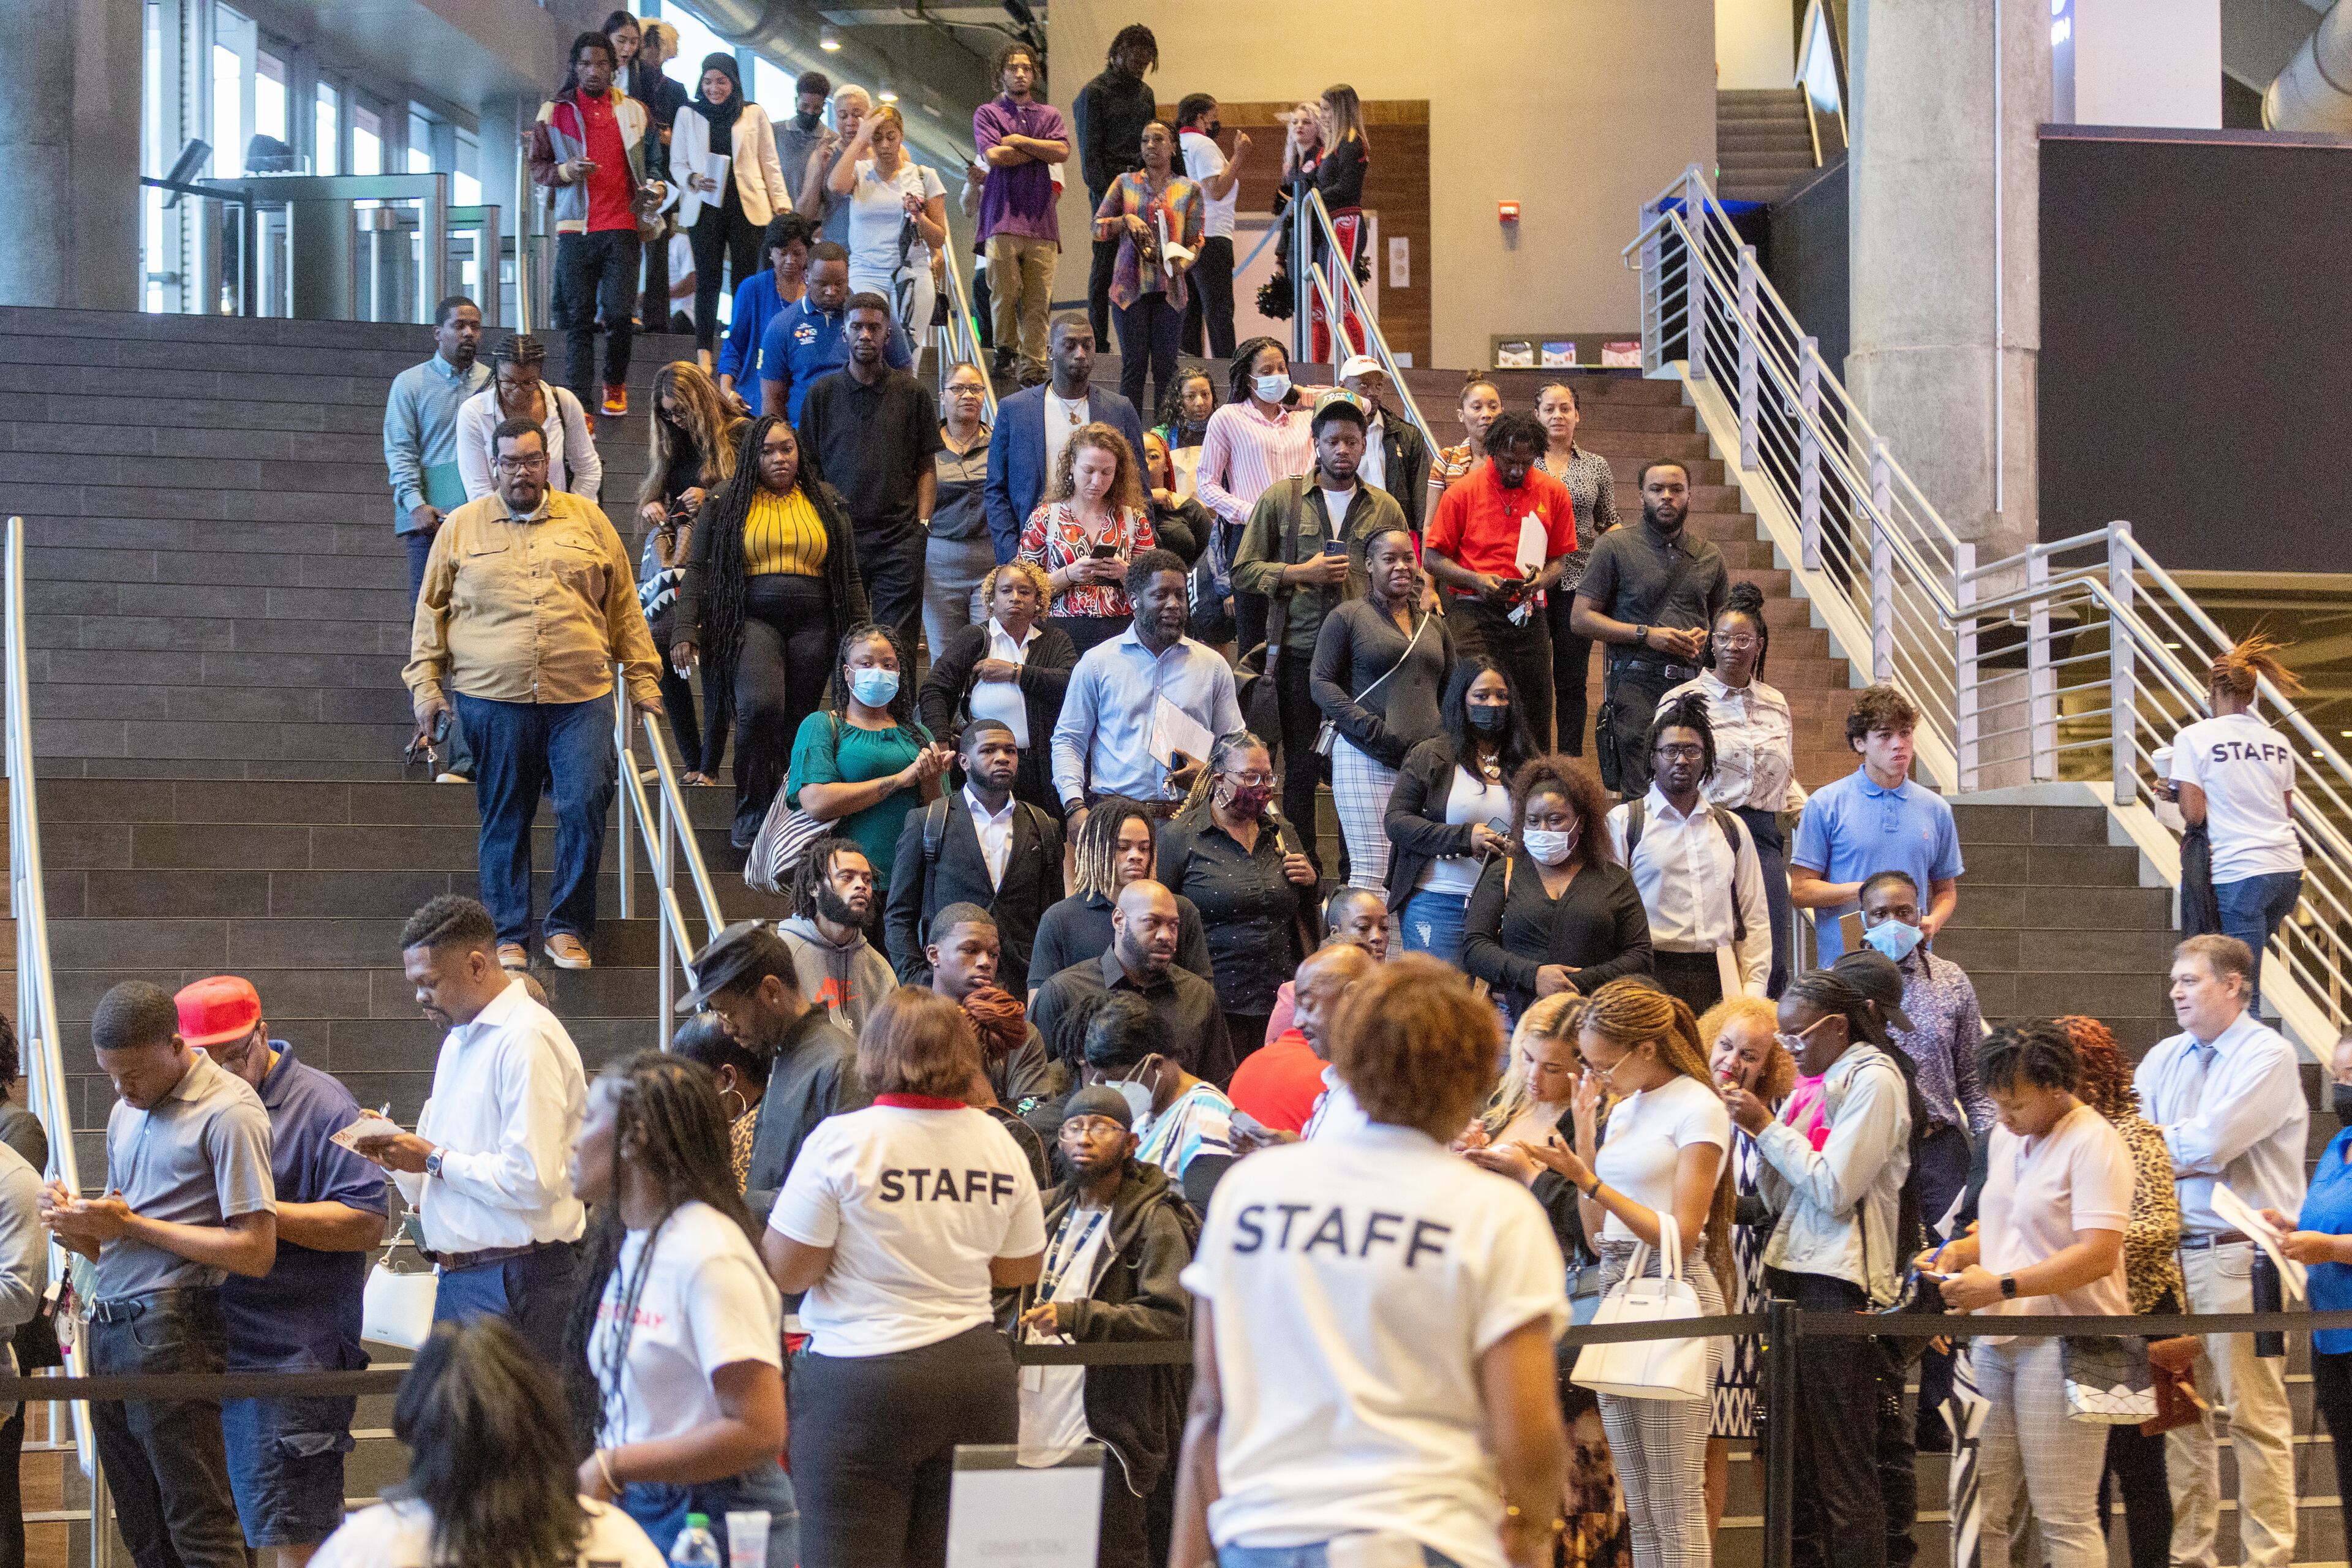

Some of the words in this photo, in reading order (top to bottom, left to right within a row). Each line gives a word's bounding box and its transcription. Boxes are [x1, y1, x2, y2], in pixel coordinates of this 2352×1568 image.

[2212, 741, 2288, 764] STAFF
[880, 1168, 1014, 1205] STAFF
[1232, 1204, 1453, 1268] STAFF
